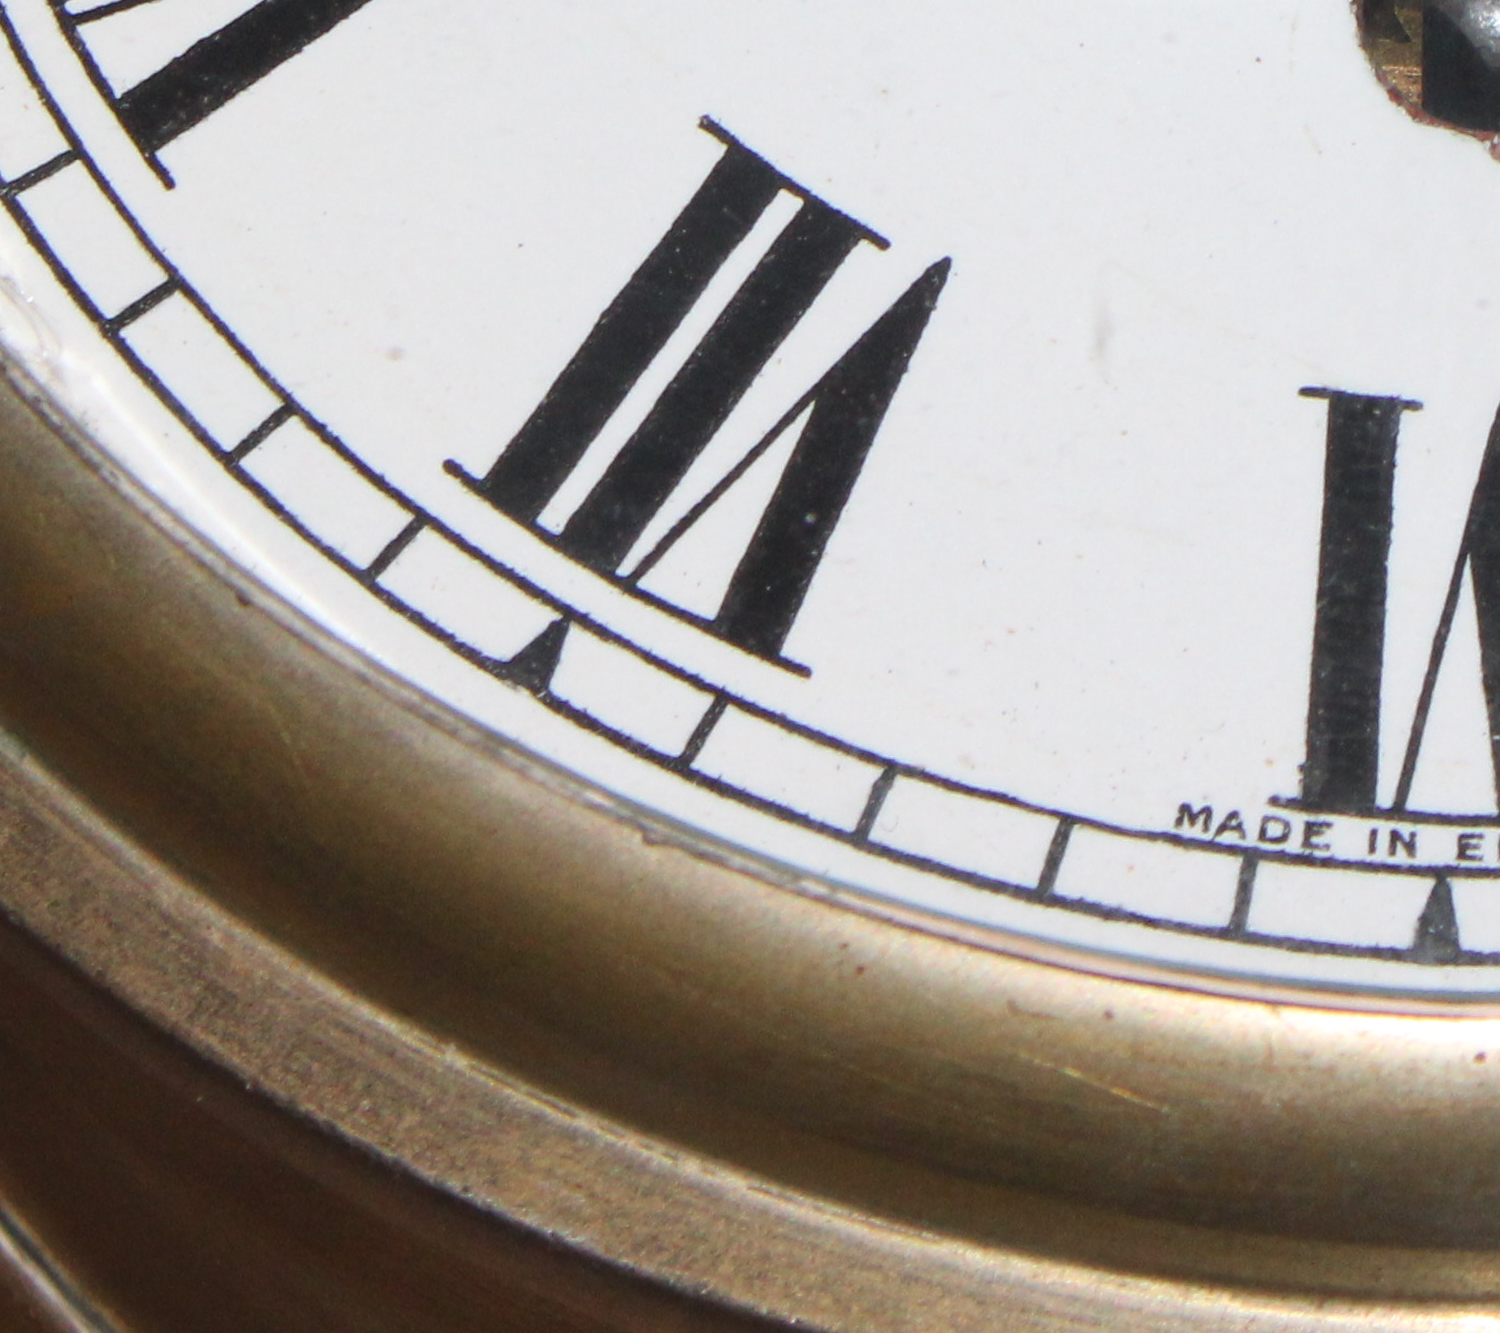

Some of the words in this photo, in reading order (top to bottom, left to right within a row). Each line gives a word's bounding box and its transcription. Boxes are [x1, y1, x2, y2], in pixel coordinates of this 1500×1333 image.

[443, 114, 953, 679] VII
[1175, 804, 1332, 851] MADE
[1367, 826, 1418, 860] IN
